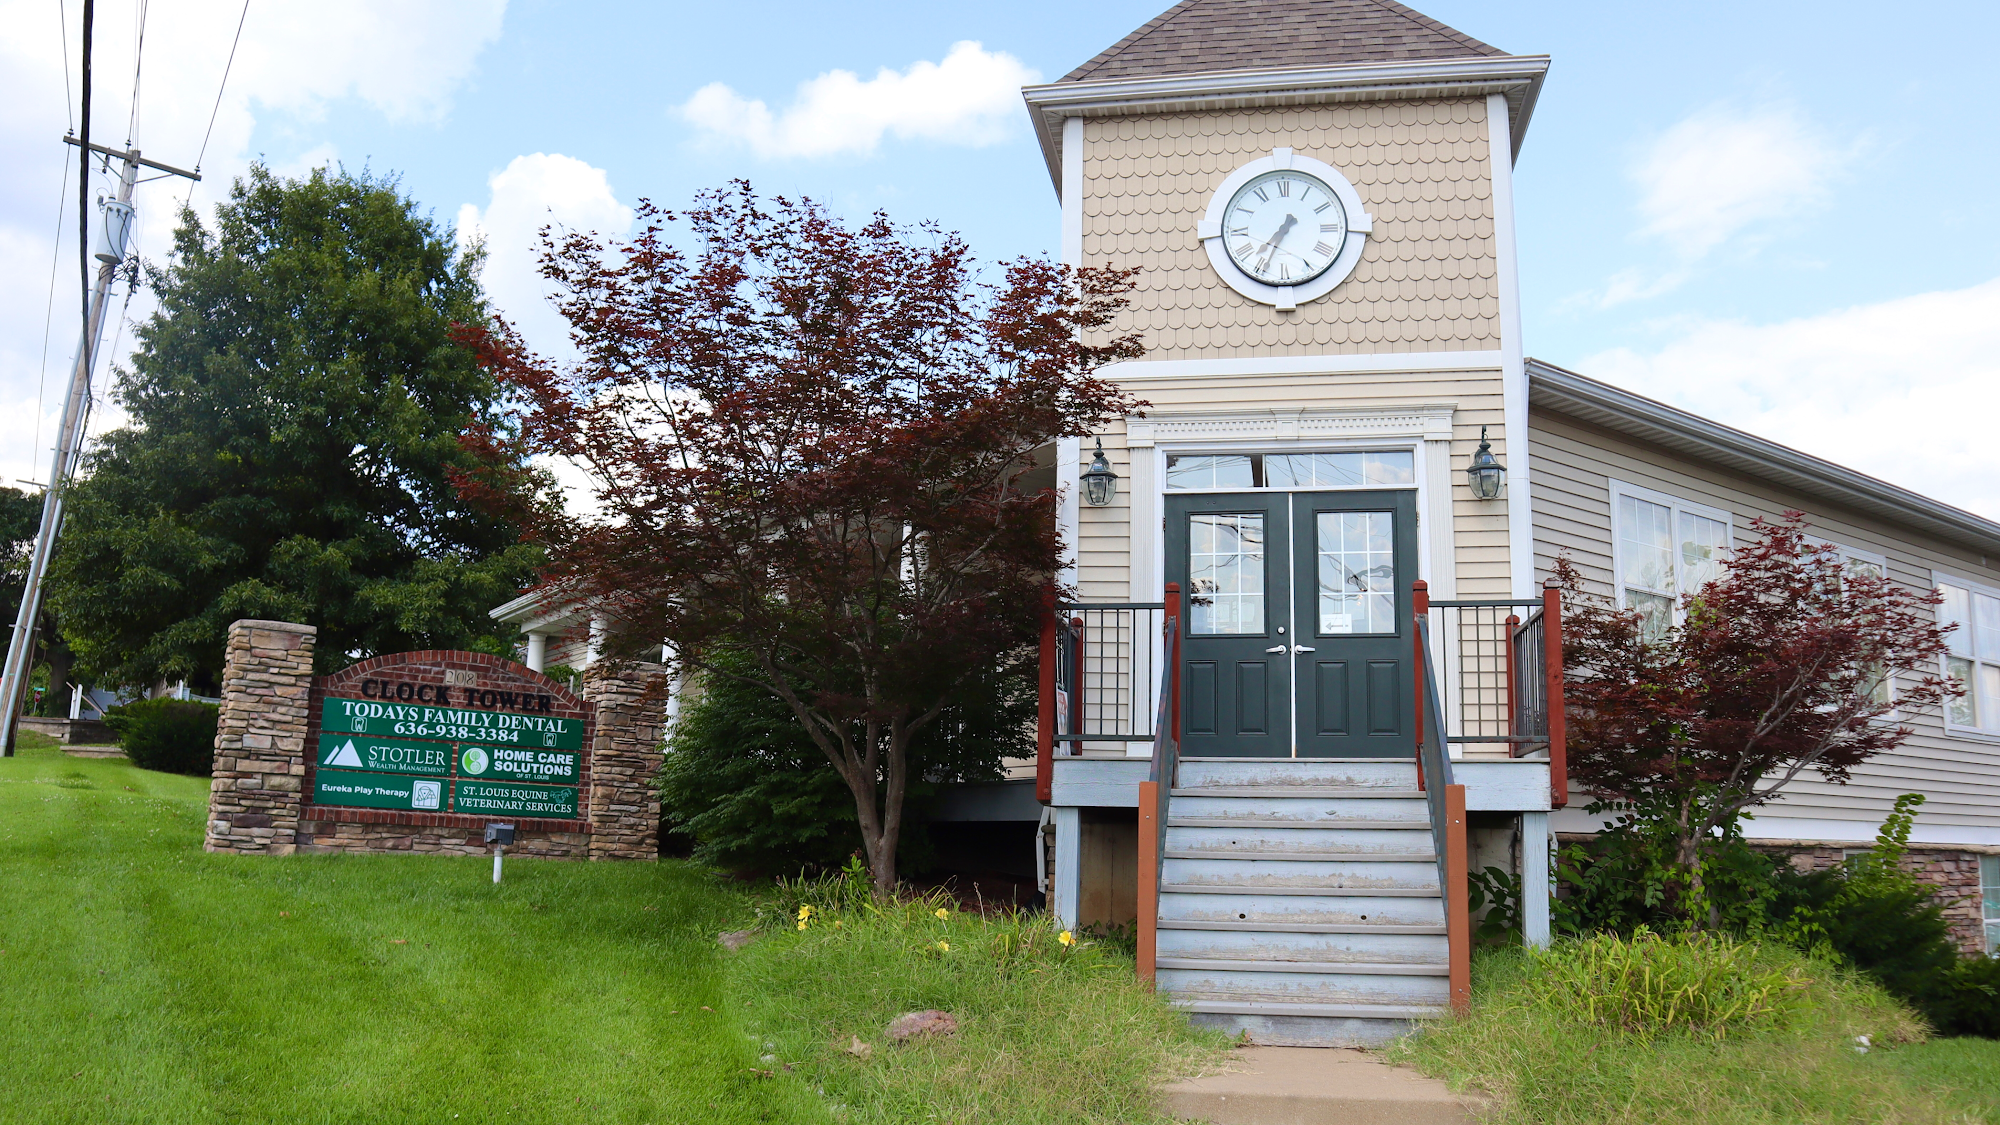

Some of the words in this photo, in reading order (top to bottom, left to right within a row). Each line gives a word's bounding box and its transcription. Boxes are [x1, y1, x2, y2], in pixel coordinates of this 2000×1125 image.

[447, 670, 474, 686] 208
[361, 678, 451, 705] CLOCK
[463, 688, 551, 712] TOWER
[342, 701, 419, 721] TODAYS
[423, 708, 494, 727] FAMILY
[498, 714, 568, 733] DENTAL
[394, 721, 519, 743] 636-938-3384
[368, 746, 446, 766] STOTLER
[493, 749, 534, 762] HOME
[538, 753, 574, 765] CARE
[493, 761, 572, 776] SOLUTIONS
[321, 784, 352, 793] Eureka
[354, 786, 374, 796] Play
[375, 787, 410, 799] Therapy
[462, 786, 478, 796] ST.
[479, 787, 510, 798] LOUIS
[511, 789, 549, 800] EQUINE
[459, 797, 524, 810] VETERINARY
[525, 802, 572, 814] SERVICES
